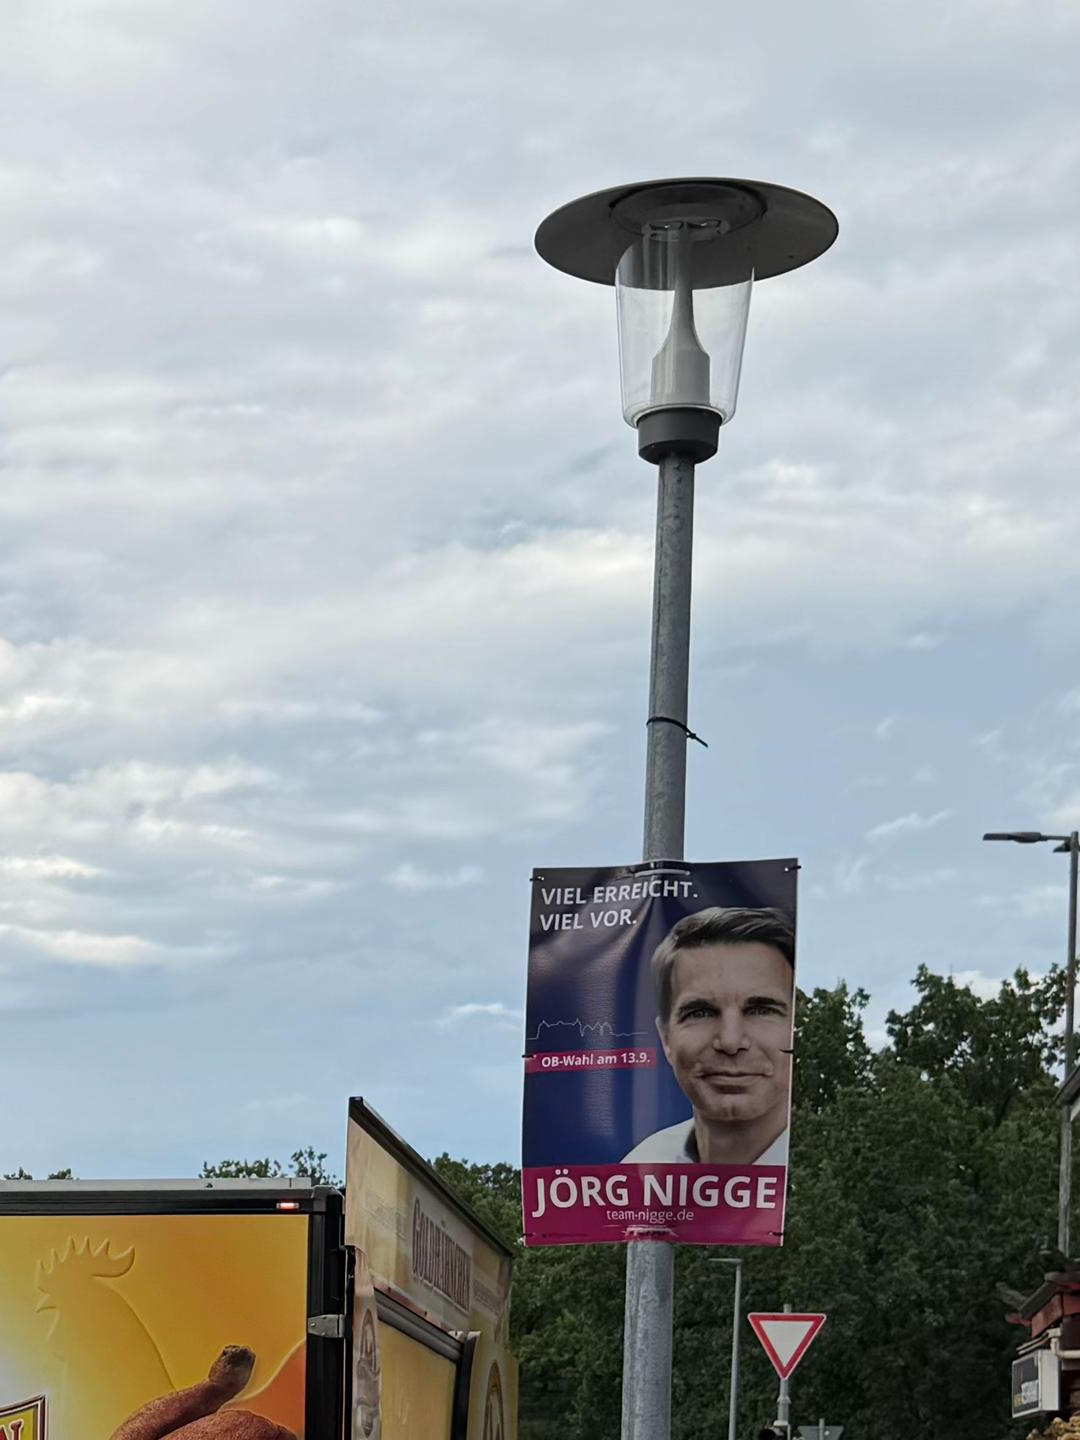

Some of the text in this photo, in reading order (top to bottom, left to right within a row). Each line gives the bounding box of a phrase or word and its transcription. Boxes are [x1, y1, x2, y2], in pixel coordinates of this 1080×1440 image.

[541, 880, 699, 905] VIEL ERREICHT.
[540, 909, 638, 931] VIEL VOR.
[541, 1052, 651, 1068] OB-Wahl am 13.9.
[532, 1168, 778, 1218] JÖRG NIGGE
[606, 1208, 695, 1224] team-nigge.de
